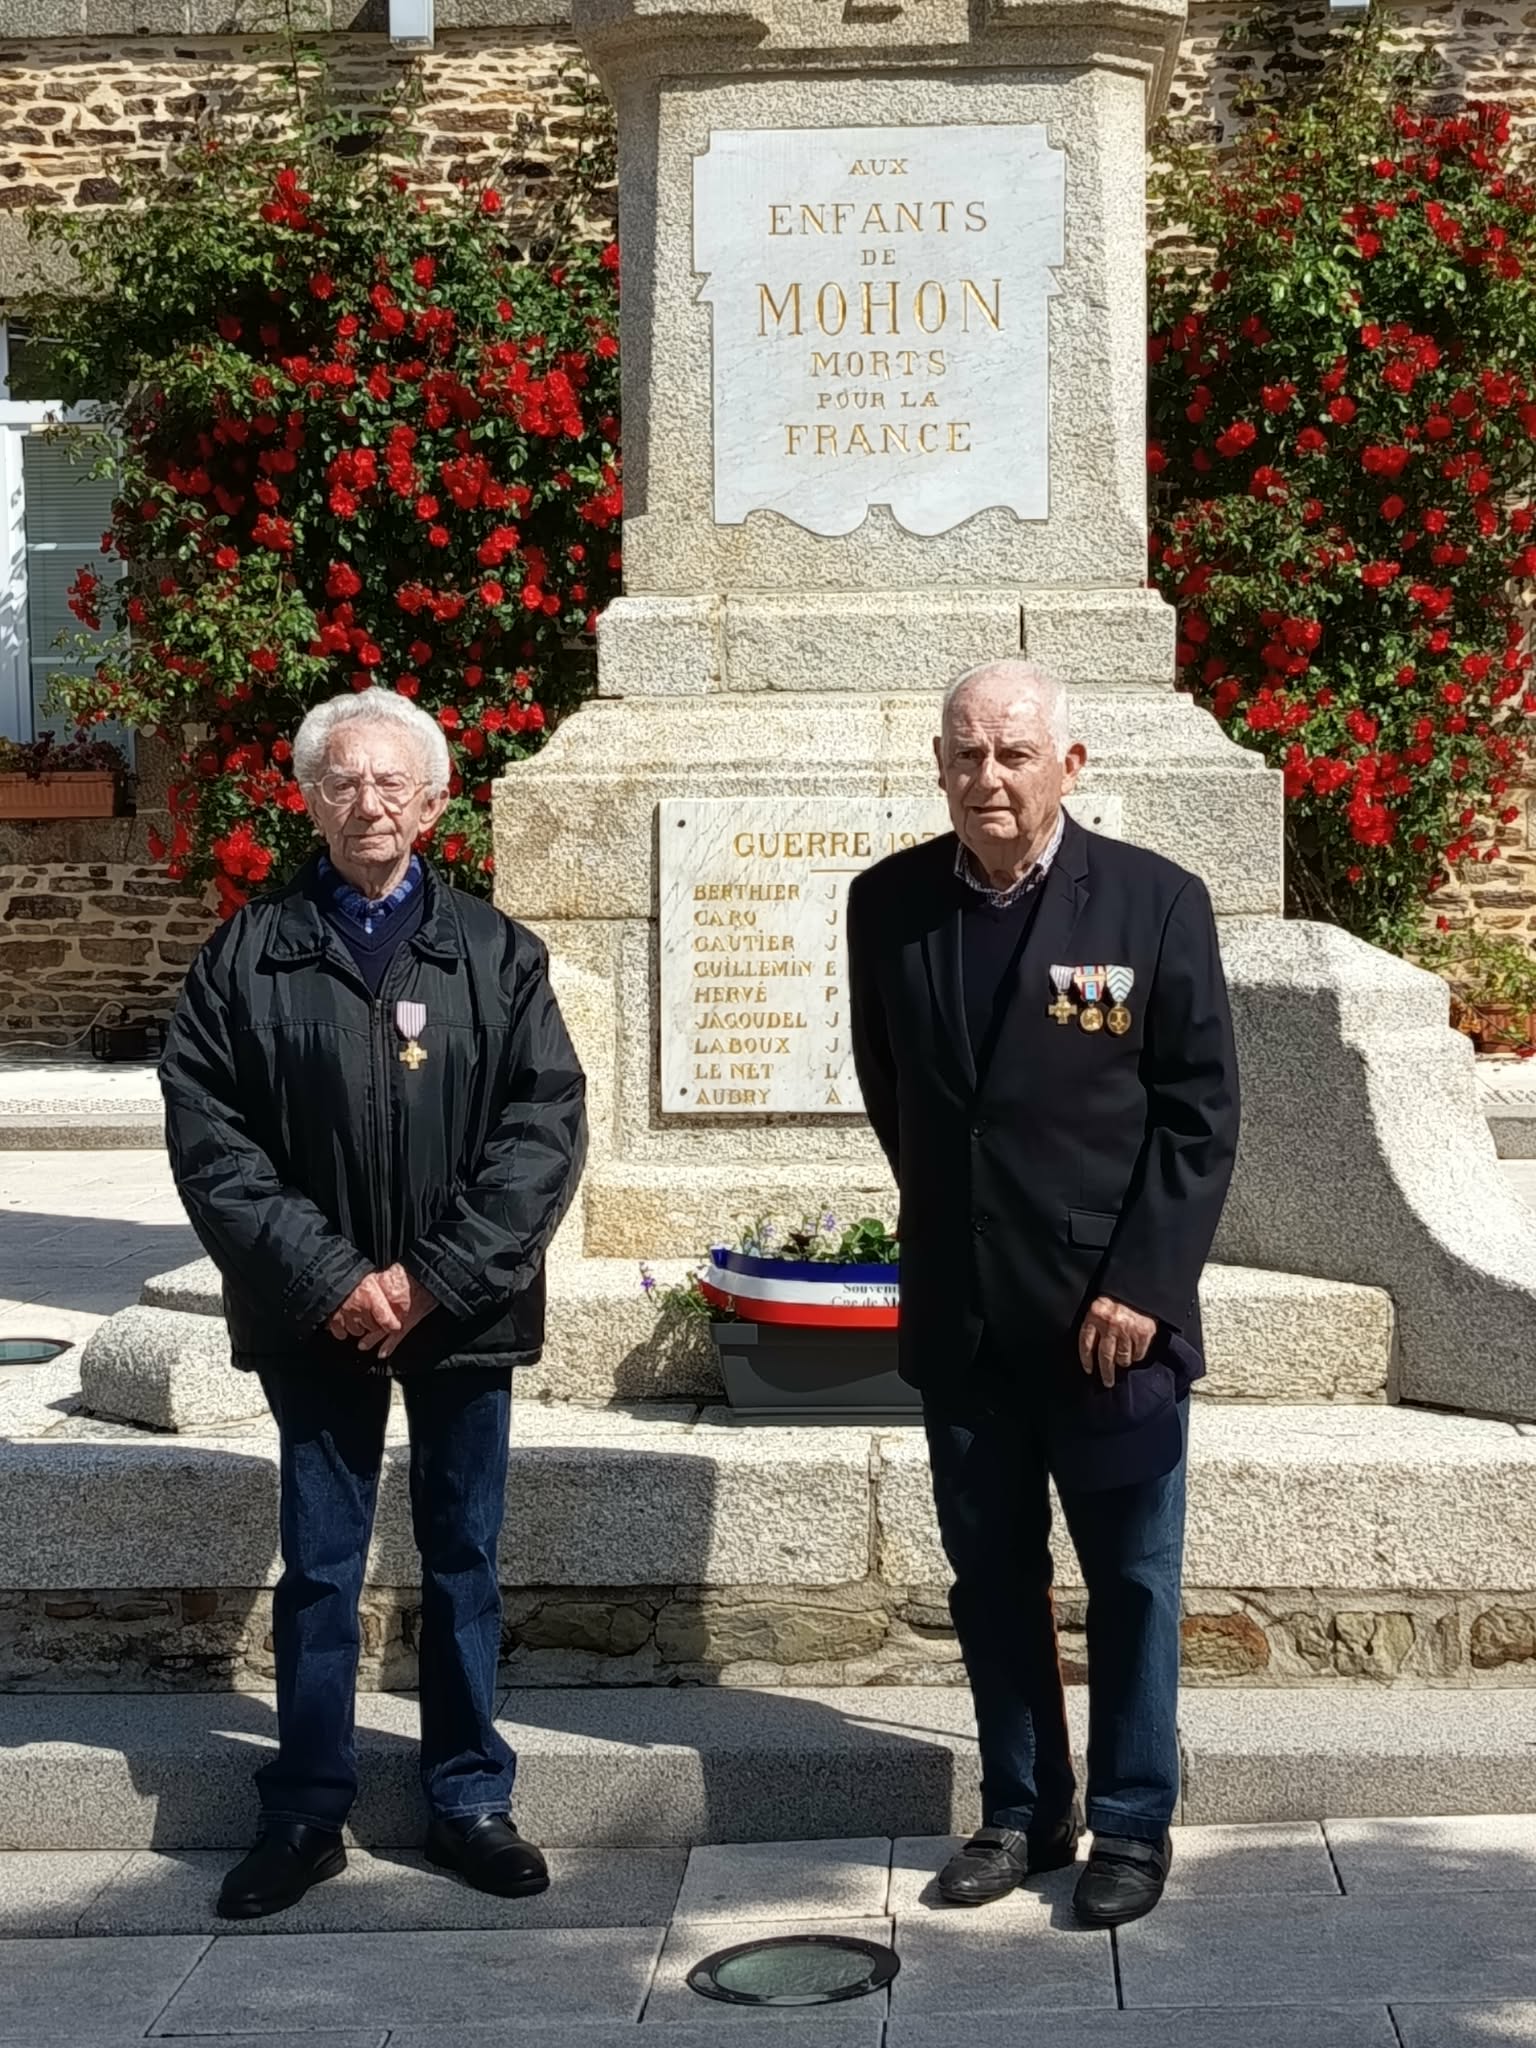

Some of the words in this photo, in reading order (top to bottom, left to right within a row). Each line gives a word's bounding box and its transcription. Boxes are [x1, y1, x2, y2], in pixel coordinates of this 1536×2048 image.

[849, 159, 908, 175] AUX
[768, 201, 987, 235] ENFANTS
[861, 250, 896, 265] DE
[755, 279, 1004, 336] MOHON
[811, 351, 945, 378] MORTS
[817, 392, 885, 409] POUR
[901, 392, 939, 407] LA
[785, 422, 971, 456] FRANCE
[735, 832, 871, 857] GUERRE
[692, 884, 799, 900] BERTHIER
[695, 910, 756, 926] CARO
[695, 982, 767, 1003] HERVÉ
[695, 1038, 791, 1054] LABOUX
[696, 1064, 721, 1079] LE
[731, 1064, 774, 1079] NET
[696, 1089, 770, 1104] AUBRY
[883, 1297, 899, 1308] M
